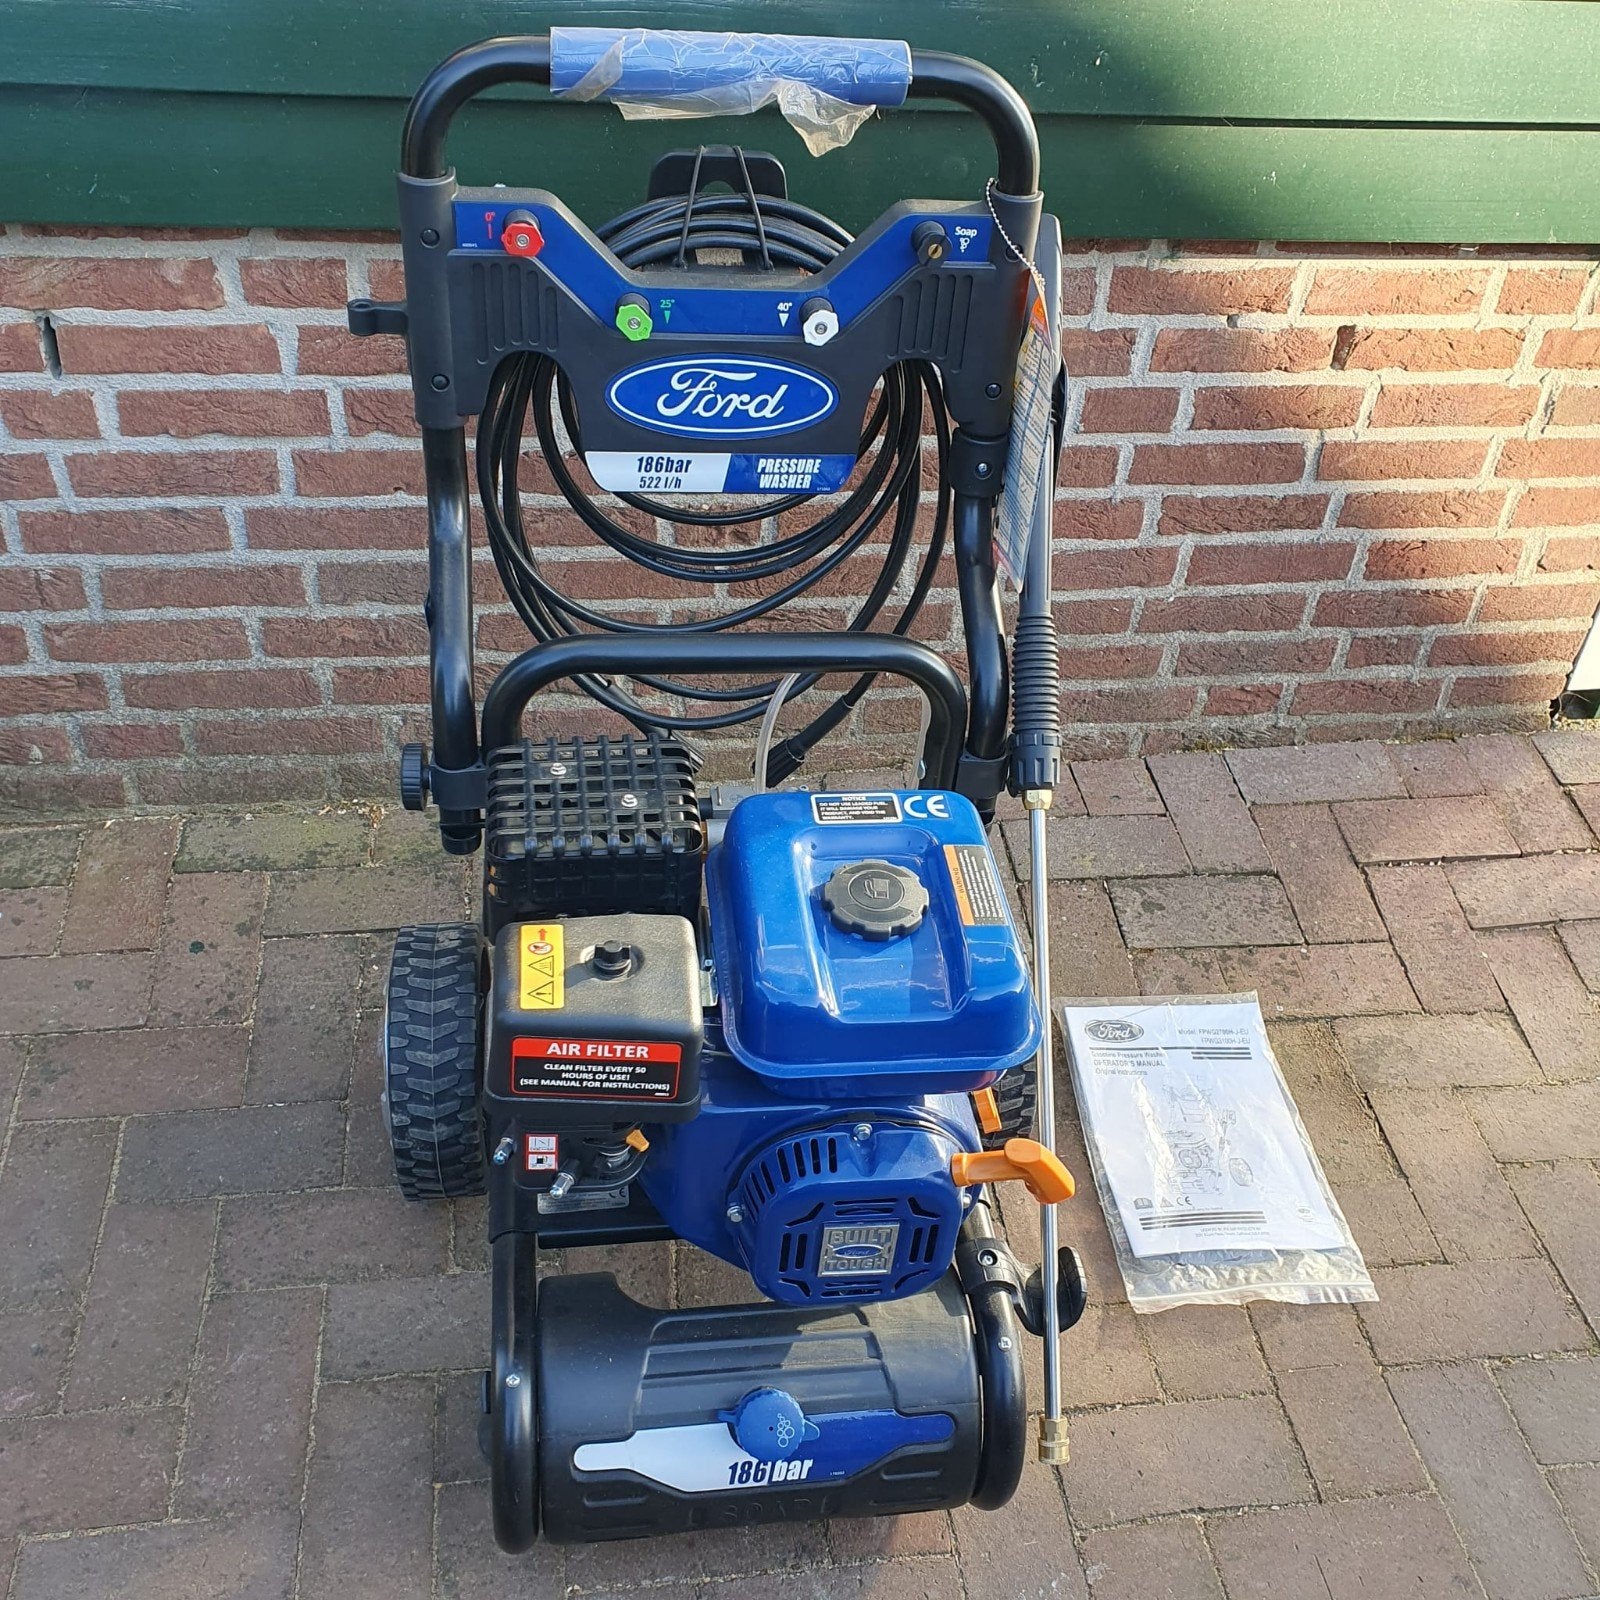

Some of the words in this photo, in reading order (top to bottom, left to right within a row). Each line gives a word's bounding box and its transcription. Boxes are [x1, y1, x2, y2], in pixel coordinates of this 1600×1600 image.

[955, 226, 978, 239] Soap
[660, 299, 675, 308] 25°
[777, 302, 793, 311] 40°
[657, 368, 788, 418] Ford
[637, 456, 692, 473] 186bar
[757, 459, 821, 473] PRESSURE
[639, 476, 662, 489] 522
[759, 474, 811, 489] WASHER
[904, 795, 949, 818] CE
[1098, 1024, 1131, 1038] Ford
[547, 1042, 580, 1056] AIR
[586, 1044, 649, 1059] FILTER
[544, 1063, 573, 1071] CLEAN
[575, 1064, 604, 1072] FILTER
[635, 1066, 646, 1074] 50
[561, 1072, 594, 1080] HOURS
[520, 1077, 539, 1086] (SEE
[540, 1079, 581, 1087] MANUAL
[602, 1081, 670, 1092] INSTRUCTIONS)
[830, 1228, 891, 1244] BUILT
[827, 1258, 887, 1270] TOUGH
